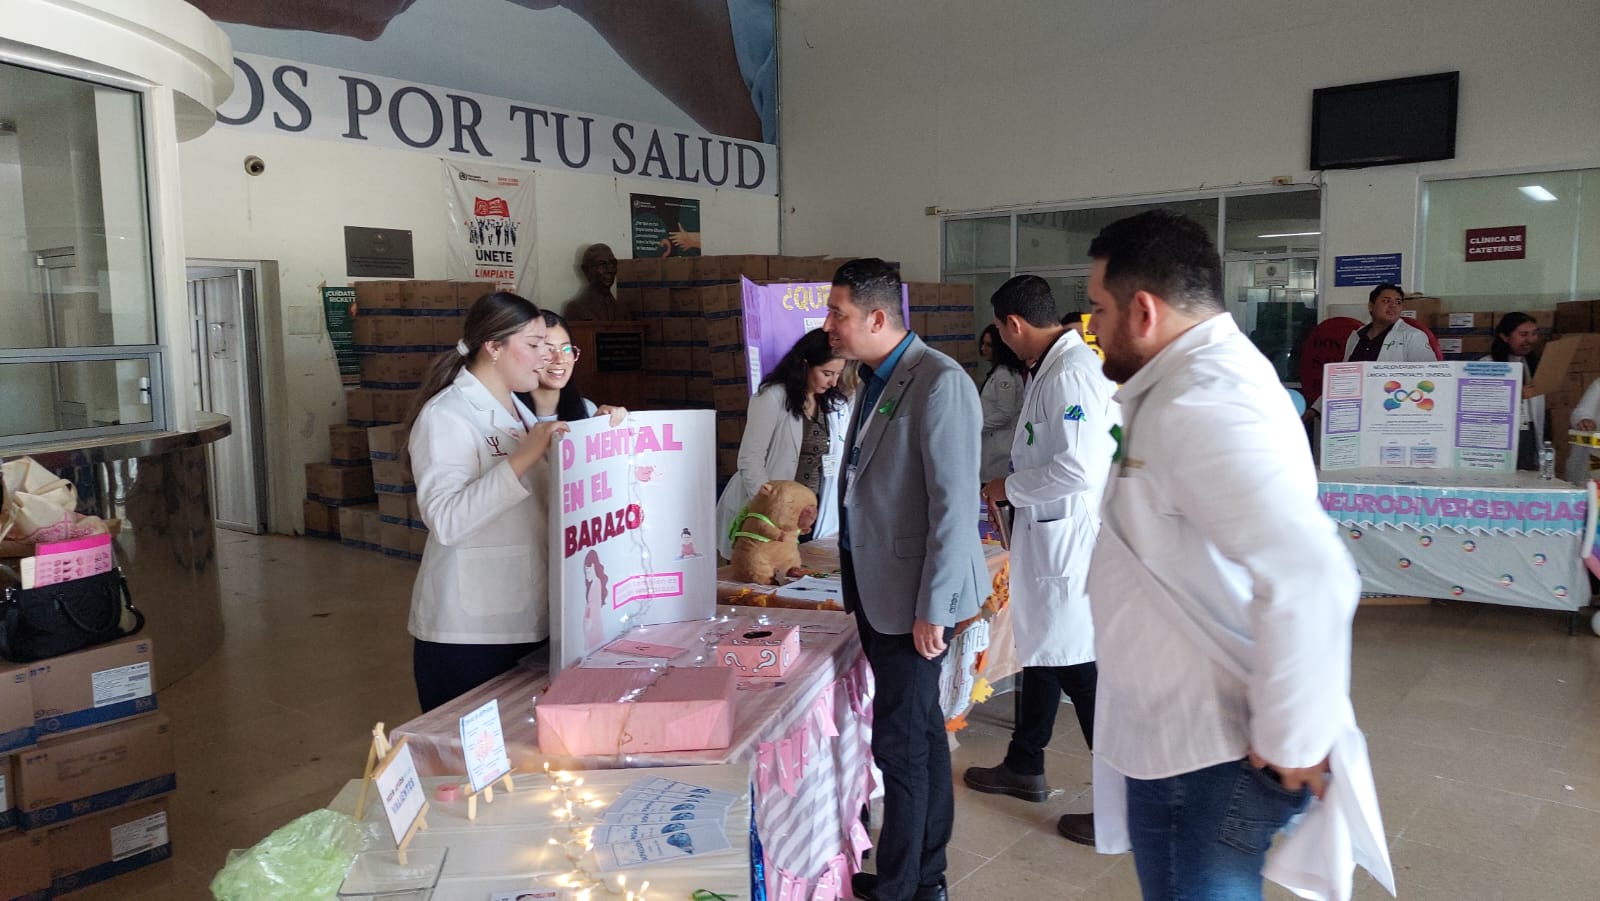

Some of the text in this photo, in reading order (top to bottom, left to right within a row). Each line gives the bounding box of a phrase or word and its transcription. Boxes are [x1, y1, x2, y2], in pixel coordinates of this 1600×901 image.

[215, 56, 766, 190] OS POR TU SALUD
[475, 246, 513, 263] ÚNETE
[1469, 245, 1523, 254] CATETERES
[1508, 234, 1522, 242] DE
[585, 423, 683, 463] MENTAL
[563, 470, 612, 514] EN EL
[564, 503, 642, 559] BARAZO
